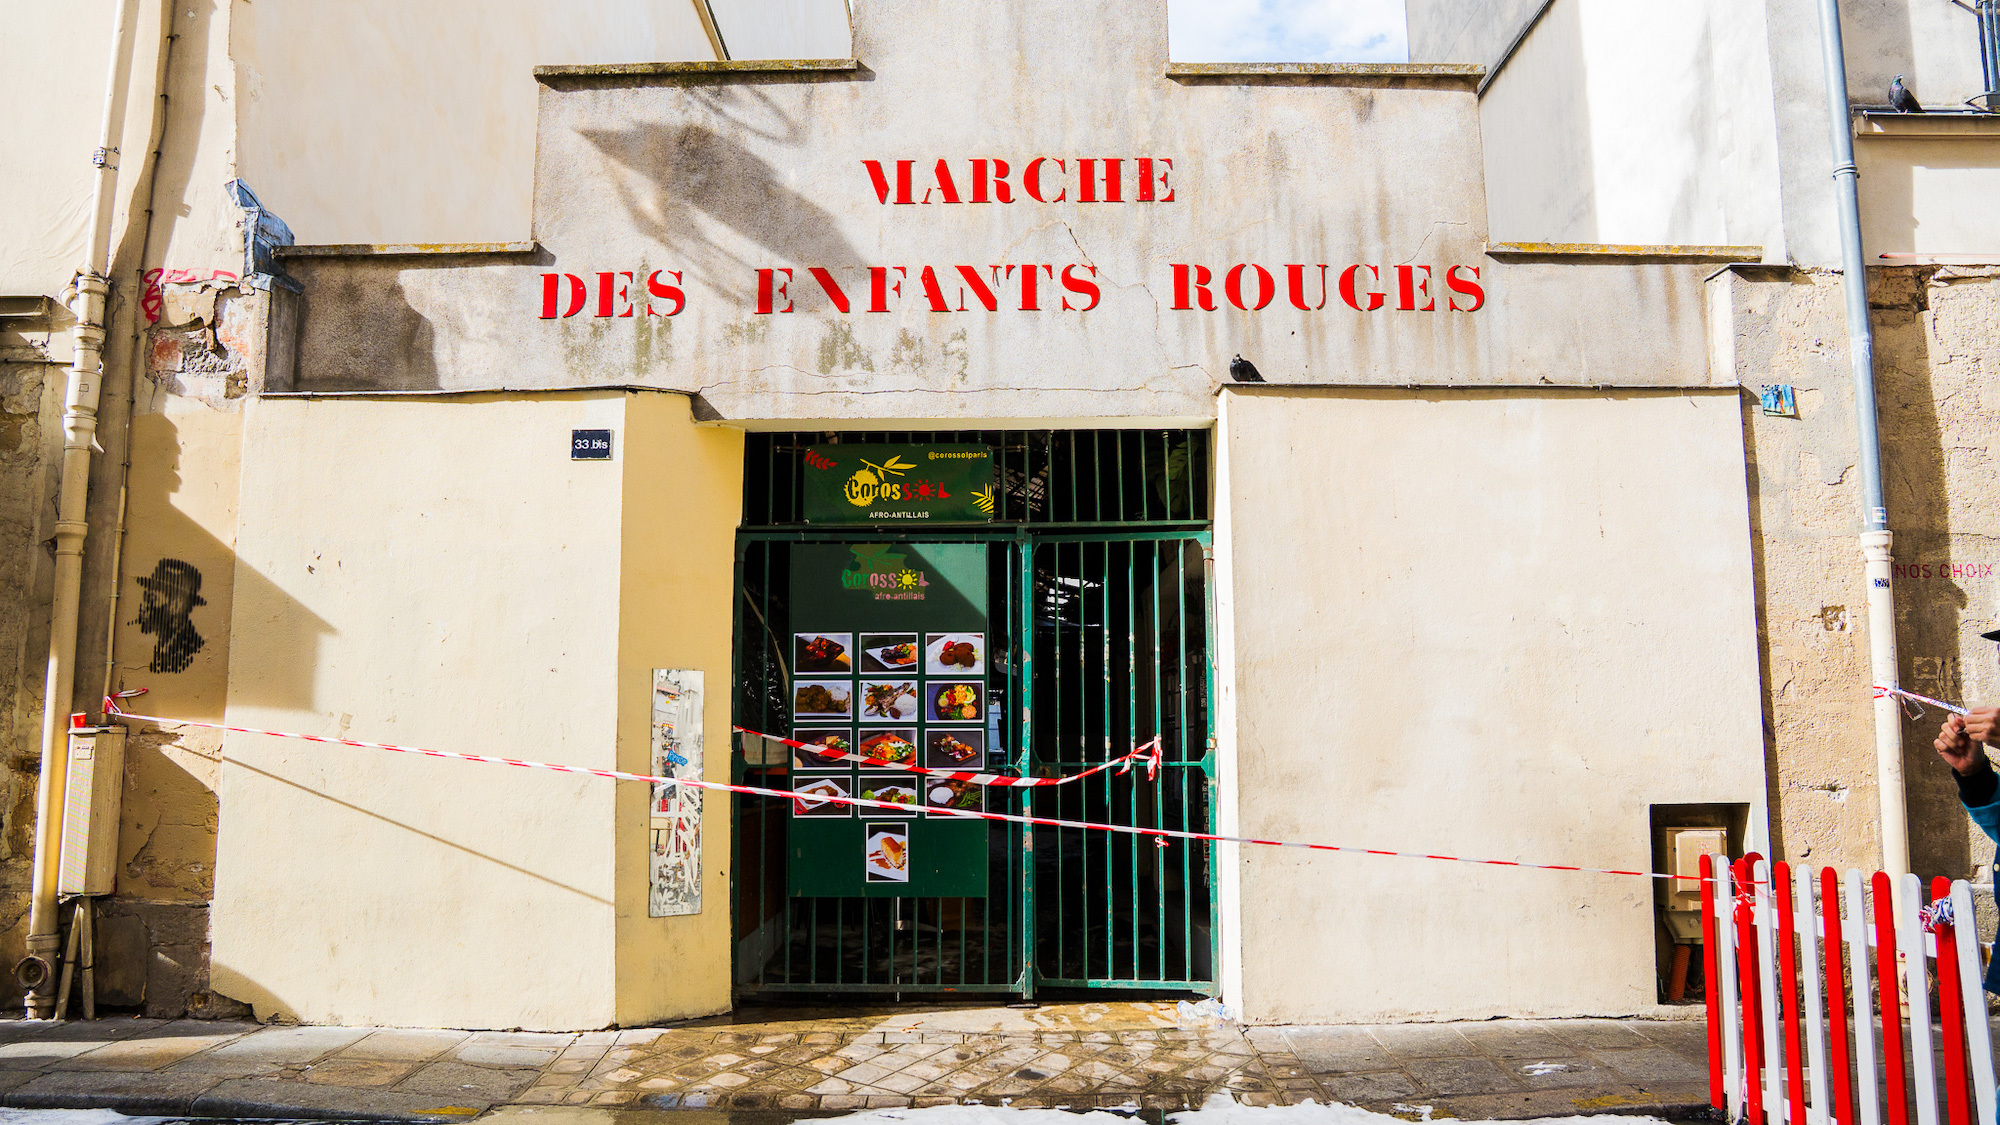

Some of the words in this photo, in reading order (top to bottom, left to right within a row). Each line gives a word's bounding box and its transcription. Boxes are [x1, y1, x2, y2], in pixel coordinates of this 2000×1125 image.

[860, 158, 1175, 204] MARCHE
[538, 269, 686, 319] DES
[754, 263, 1101, 313] ENFANTS
[1170, 263, 1486, 312] ROUGES
[575, 439, 589, 449] 33
[592, 439, 608, 449] bis
[928, 451, 988, 460] @corossolparis
[868, 511, 930, 519] AFRO-ANTILLAIS
[1895, 564, 1932, 579] NOS
[1939, 563, 1994, 579] CHOIX
[874, 592, 925, 601] afro-antillais
